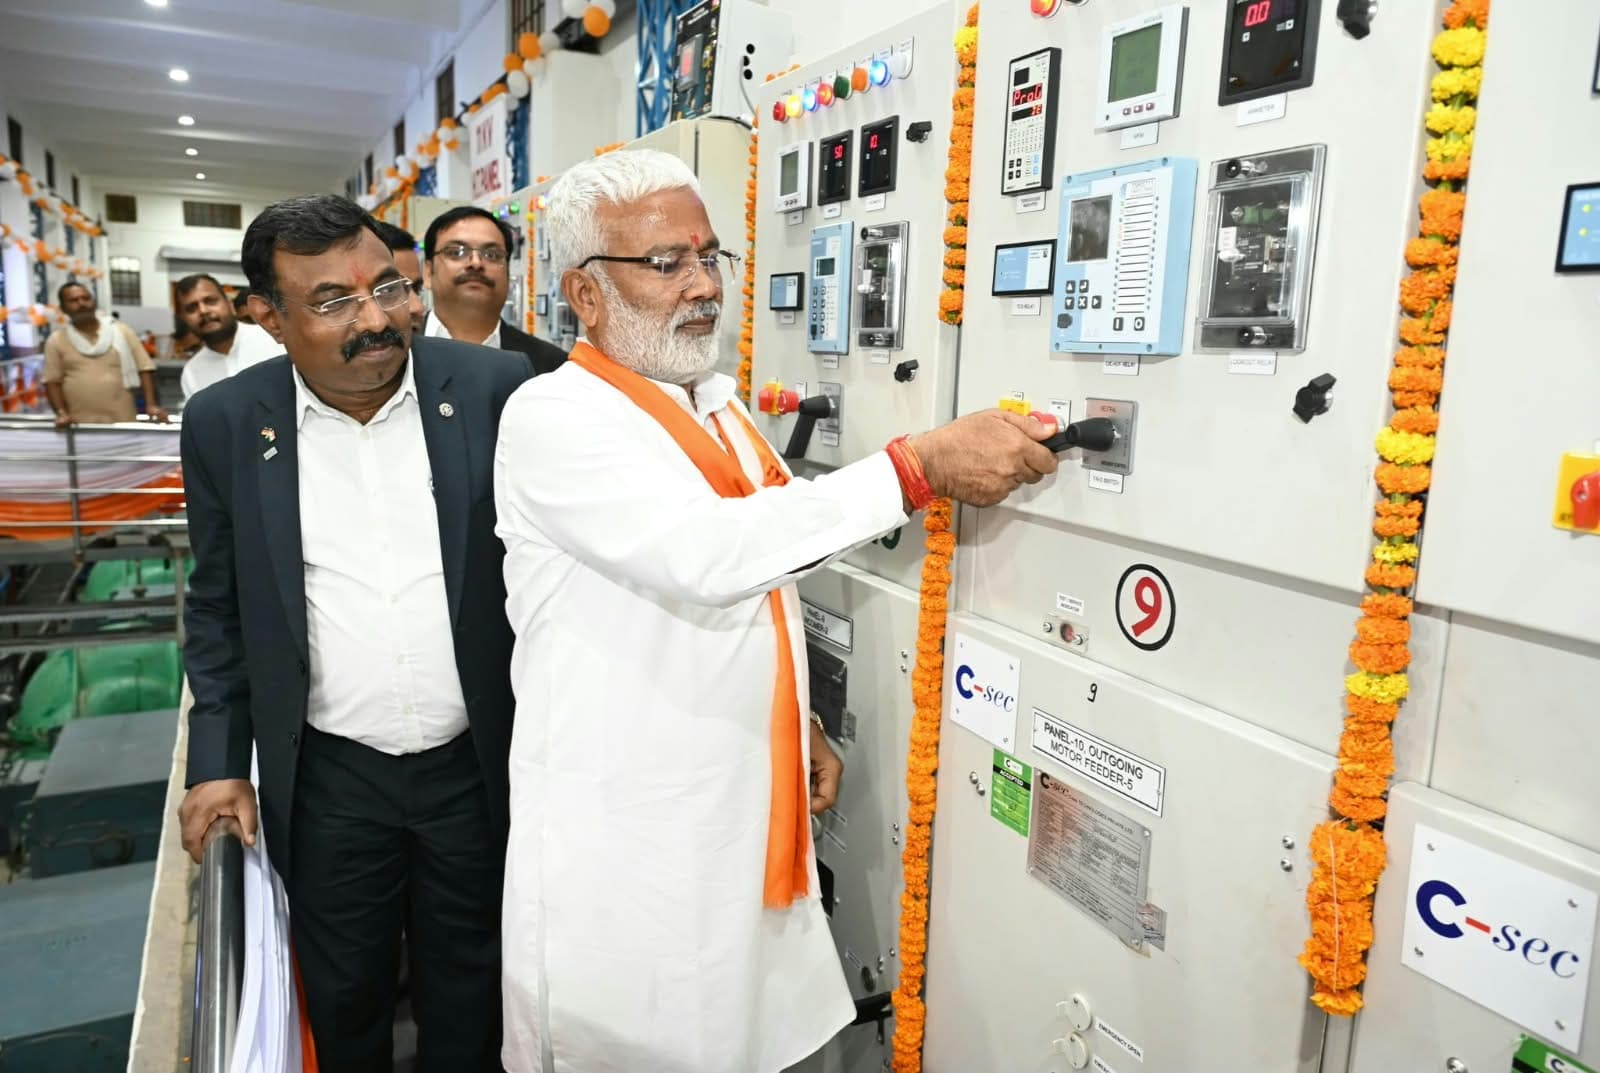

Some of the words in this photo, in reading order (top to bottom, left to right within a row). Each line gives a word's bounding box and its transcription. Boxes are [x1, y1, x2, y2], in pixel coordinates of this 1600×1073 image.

[1131, 576, 1162, 638] 9
[1050, 739, 1082, 765] MOTOR
[1084, 757, 1134, 791] FEEDER-5
[1088, 745, 1144, 780] OUTGOING
[1416, 879, 1580, 979] C-sec
